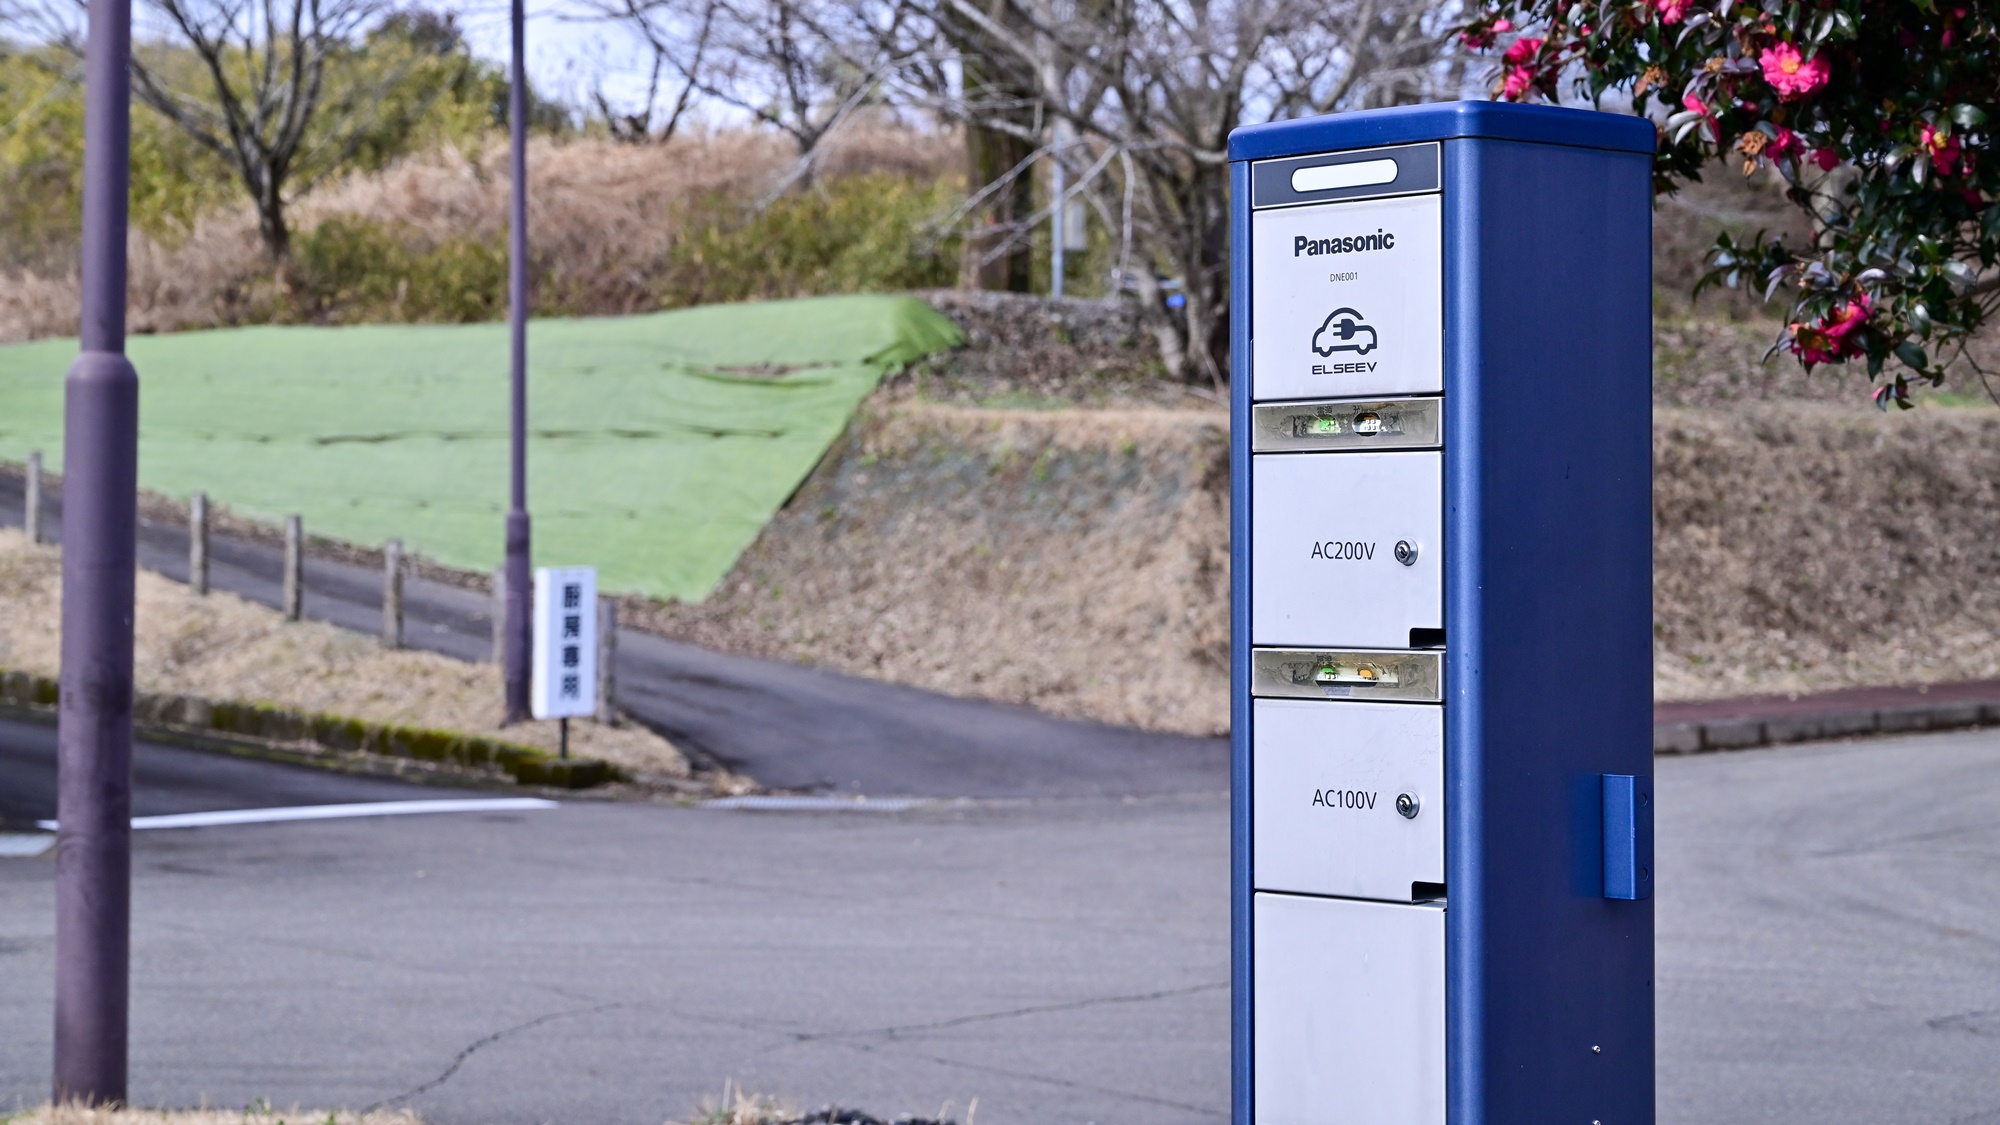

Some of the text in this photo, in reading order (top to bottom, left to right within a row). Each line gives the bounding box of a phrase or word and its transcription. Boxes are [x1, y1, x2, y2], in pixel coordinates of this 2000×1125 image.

[1294, 228, 1395, 257] Panasonic
[1329, 271, 1358, 283] DNE001
[1311, 361, 1378, 375] ELSEEV
[1311, 541, 1376, 561] AC200V
[1312, 788, 1377, 810] AC100V
